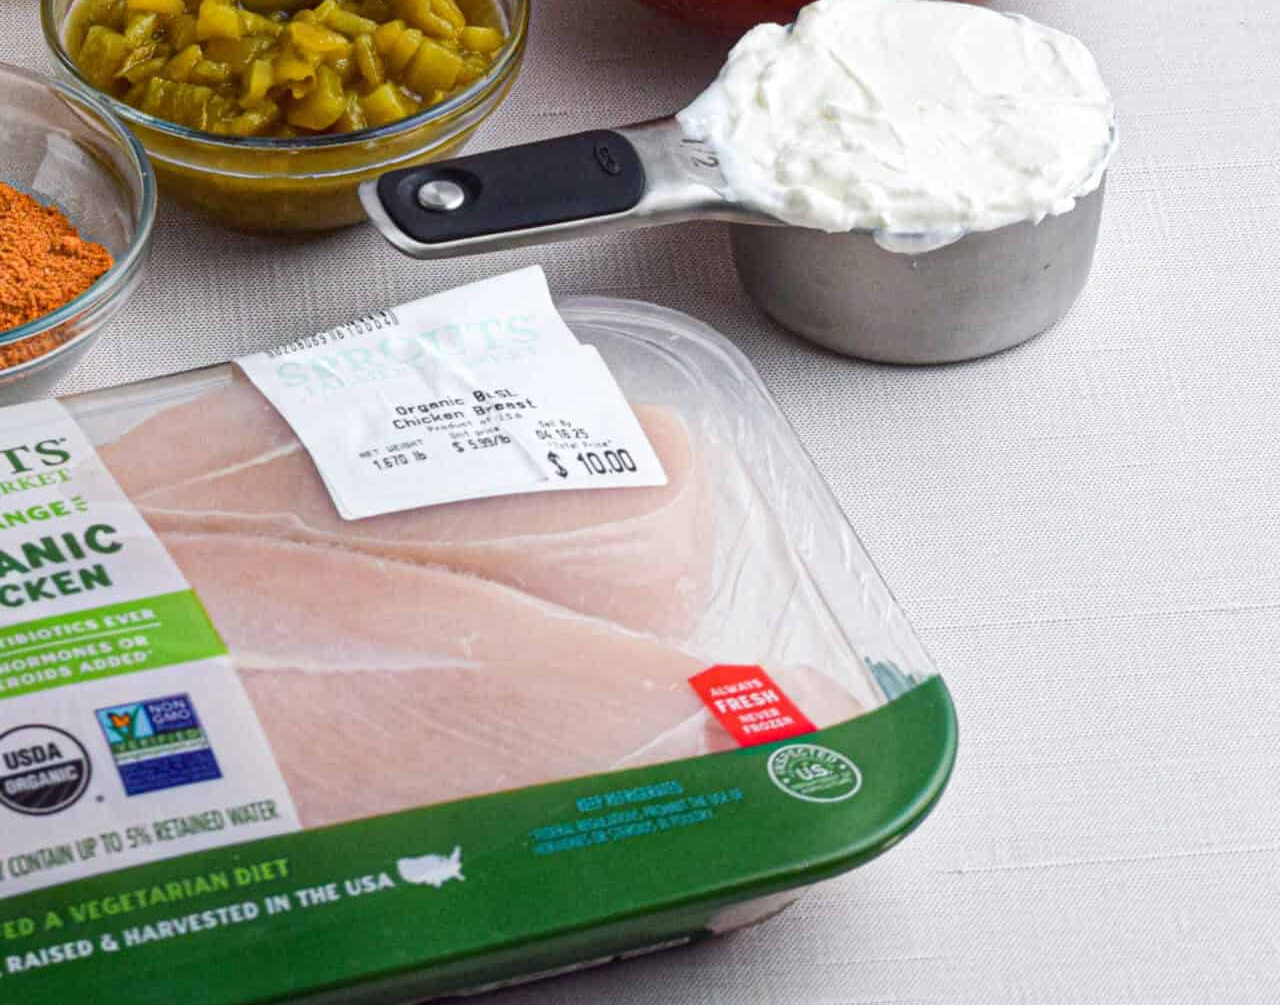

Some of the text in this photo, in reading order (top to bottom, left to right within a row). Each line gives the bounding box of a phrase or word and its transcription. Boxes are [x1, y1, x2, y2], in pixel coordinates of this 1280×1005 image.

[392, 398, 538, 430] Chicken Breast
[394, 397, 466, 417] Organic
[547, 447, 638, 479] $ 10.00
[103, 608, 156, 628] EVER
[118, 635, 149, 649] OR
[709, 678, 764, 697] ALWAYS
[148, 698, 187, 715] NON
[713, 688, 781, 715] FRESH
[737, 706, 781, 724] NEVER
[740, 715, 796, 735] FROZEN
[1, 741, 64, 771] USDA
[4, 764, 81, 794] ORGANIC
[8, 843, 76, 878] CONTAIN
[76, 837, 99, 862] UP
[100, 831, 124, 855] TO
[126, 825, 153, 850] 5%
[154, 808, 225, 843] RETAINED
[226, 799, 280, 828] WATER
[44, 910, 64, 931] A
[68, 870, 230, 924] VEGETARIAN
[233, 857, 290, 887] DIET
[6, 938, 94, 975] RAISED
[100, 933, 120, 952] &
[123, 901, 260, 948] HARVESTED
[265, 893, 291, 915] IN
[296, 882, 341, 908] THE
[344, 871, 396, 896] USA
